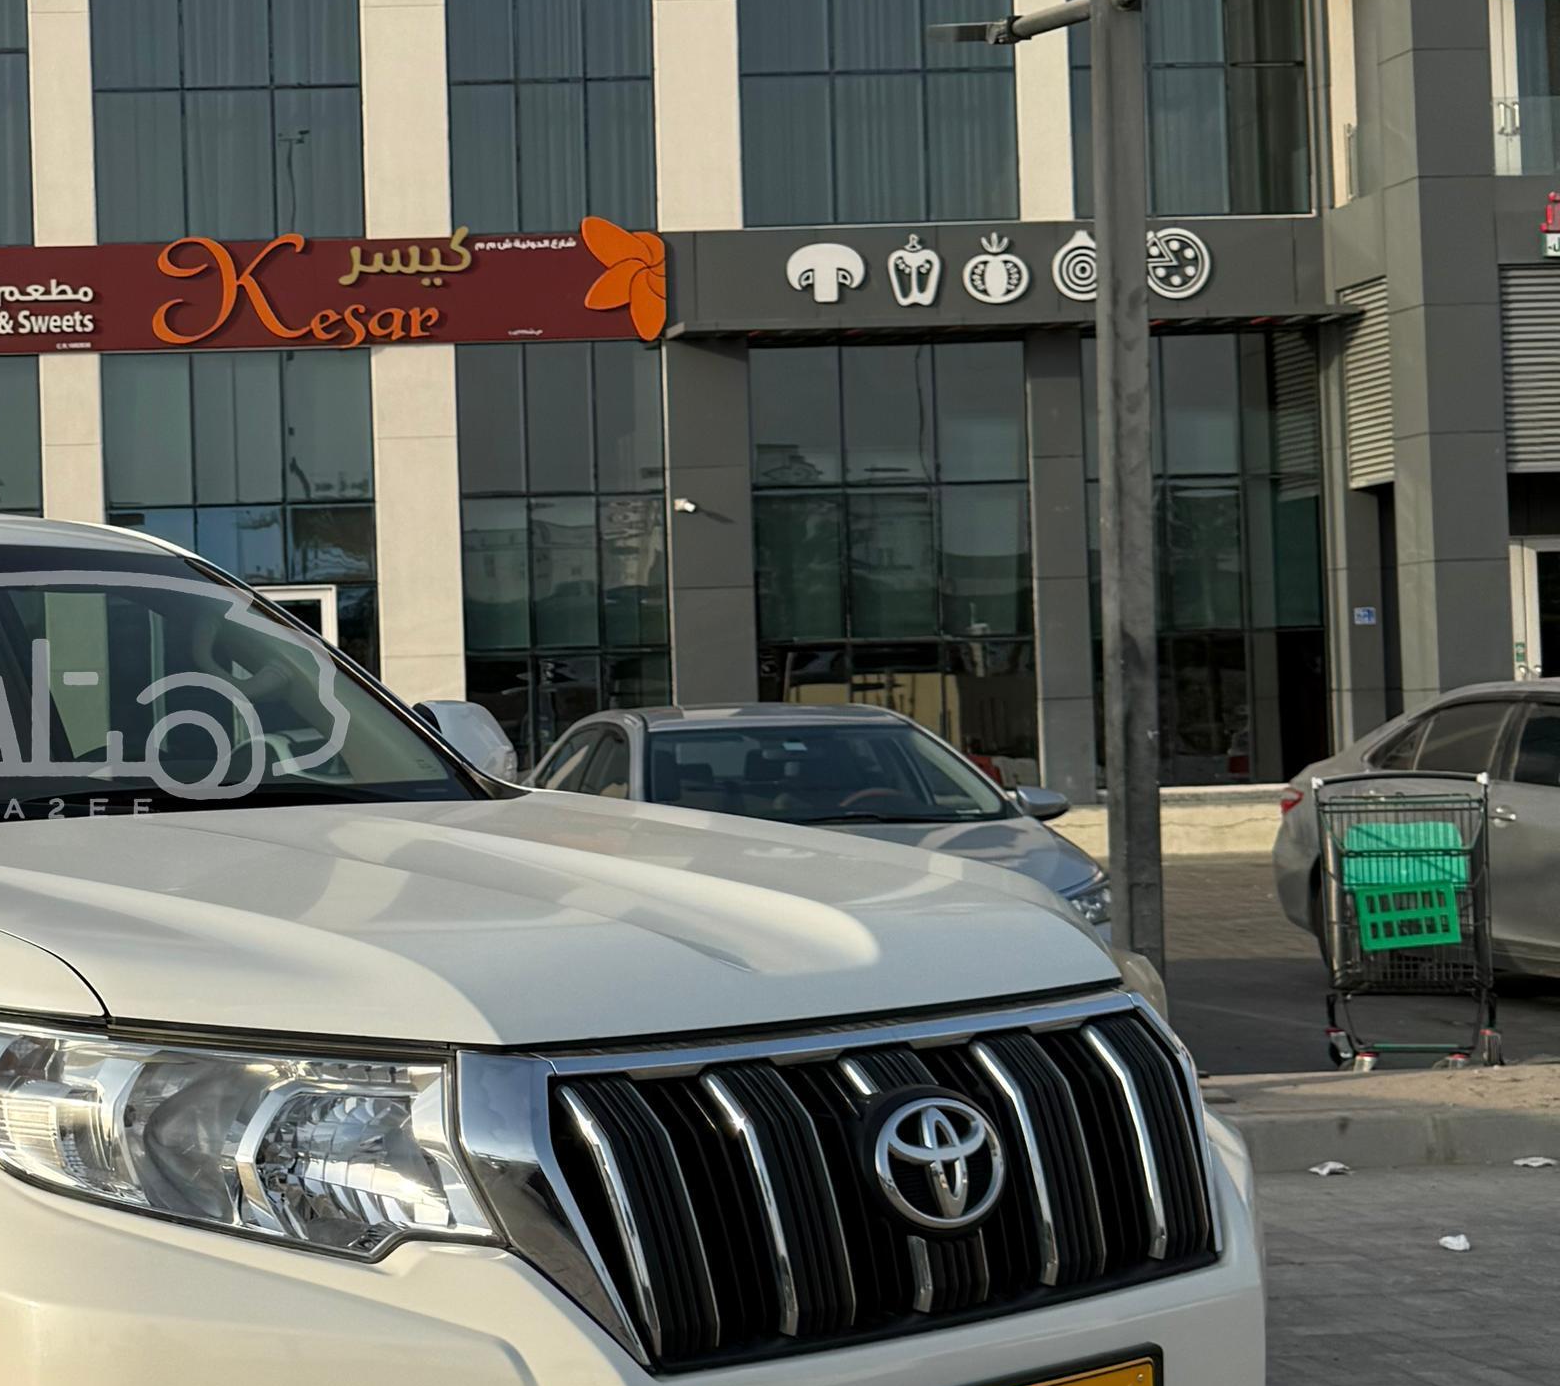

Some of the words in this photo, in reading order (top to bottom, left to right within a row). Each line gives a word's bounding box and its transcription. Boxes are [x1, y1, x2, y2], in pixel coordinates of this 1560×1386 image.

[338, 226, 472, 286] كيسر
[151, 233, 439, 349] Kesar
[17, 309, 95, 334] Sweets
